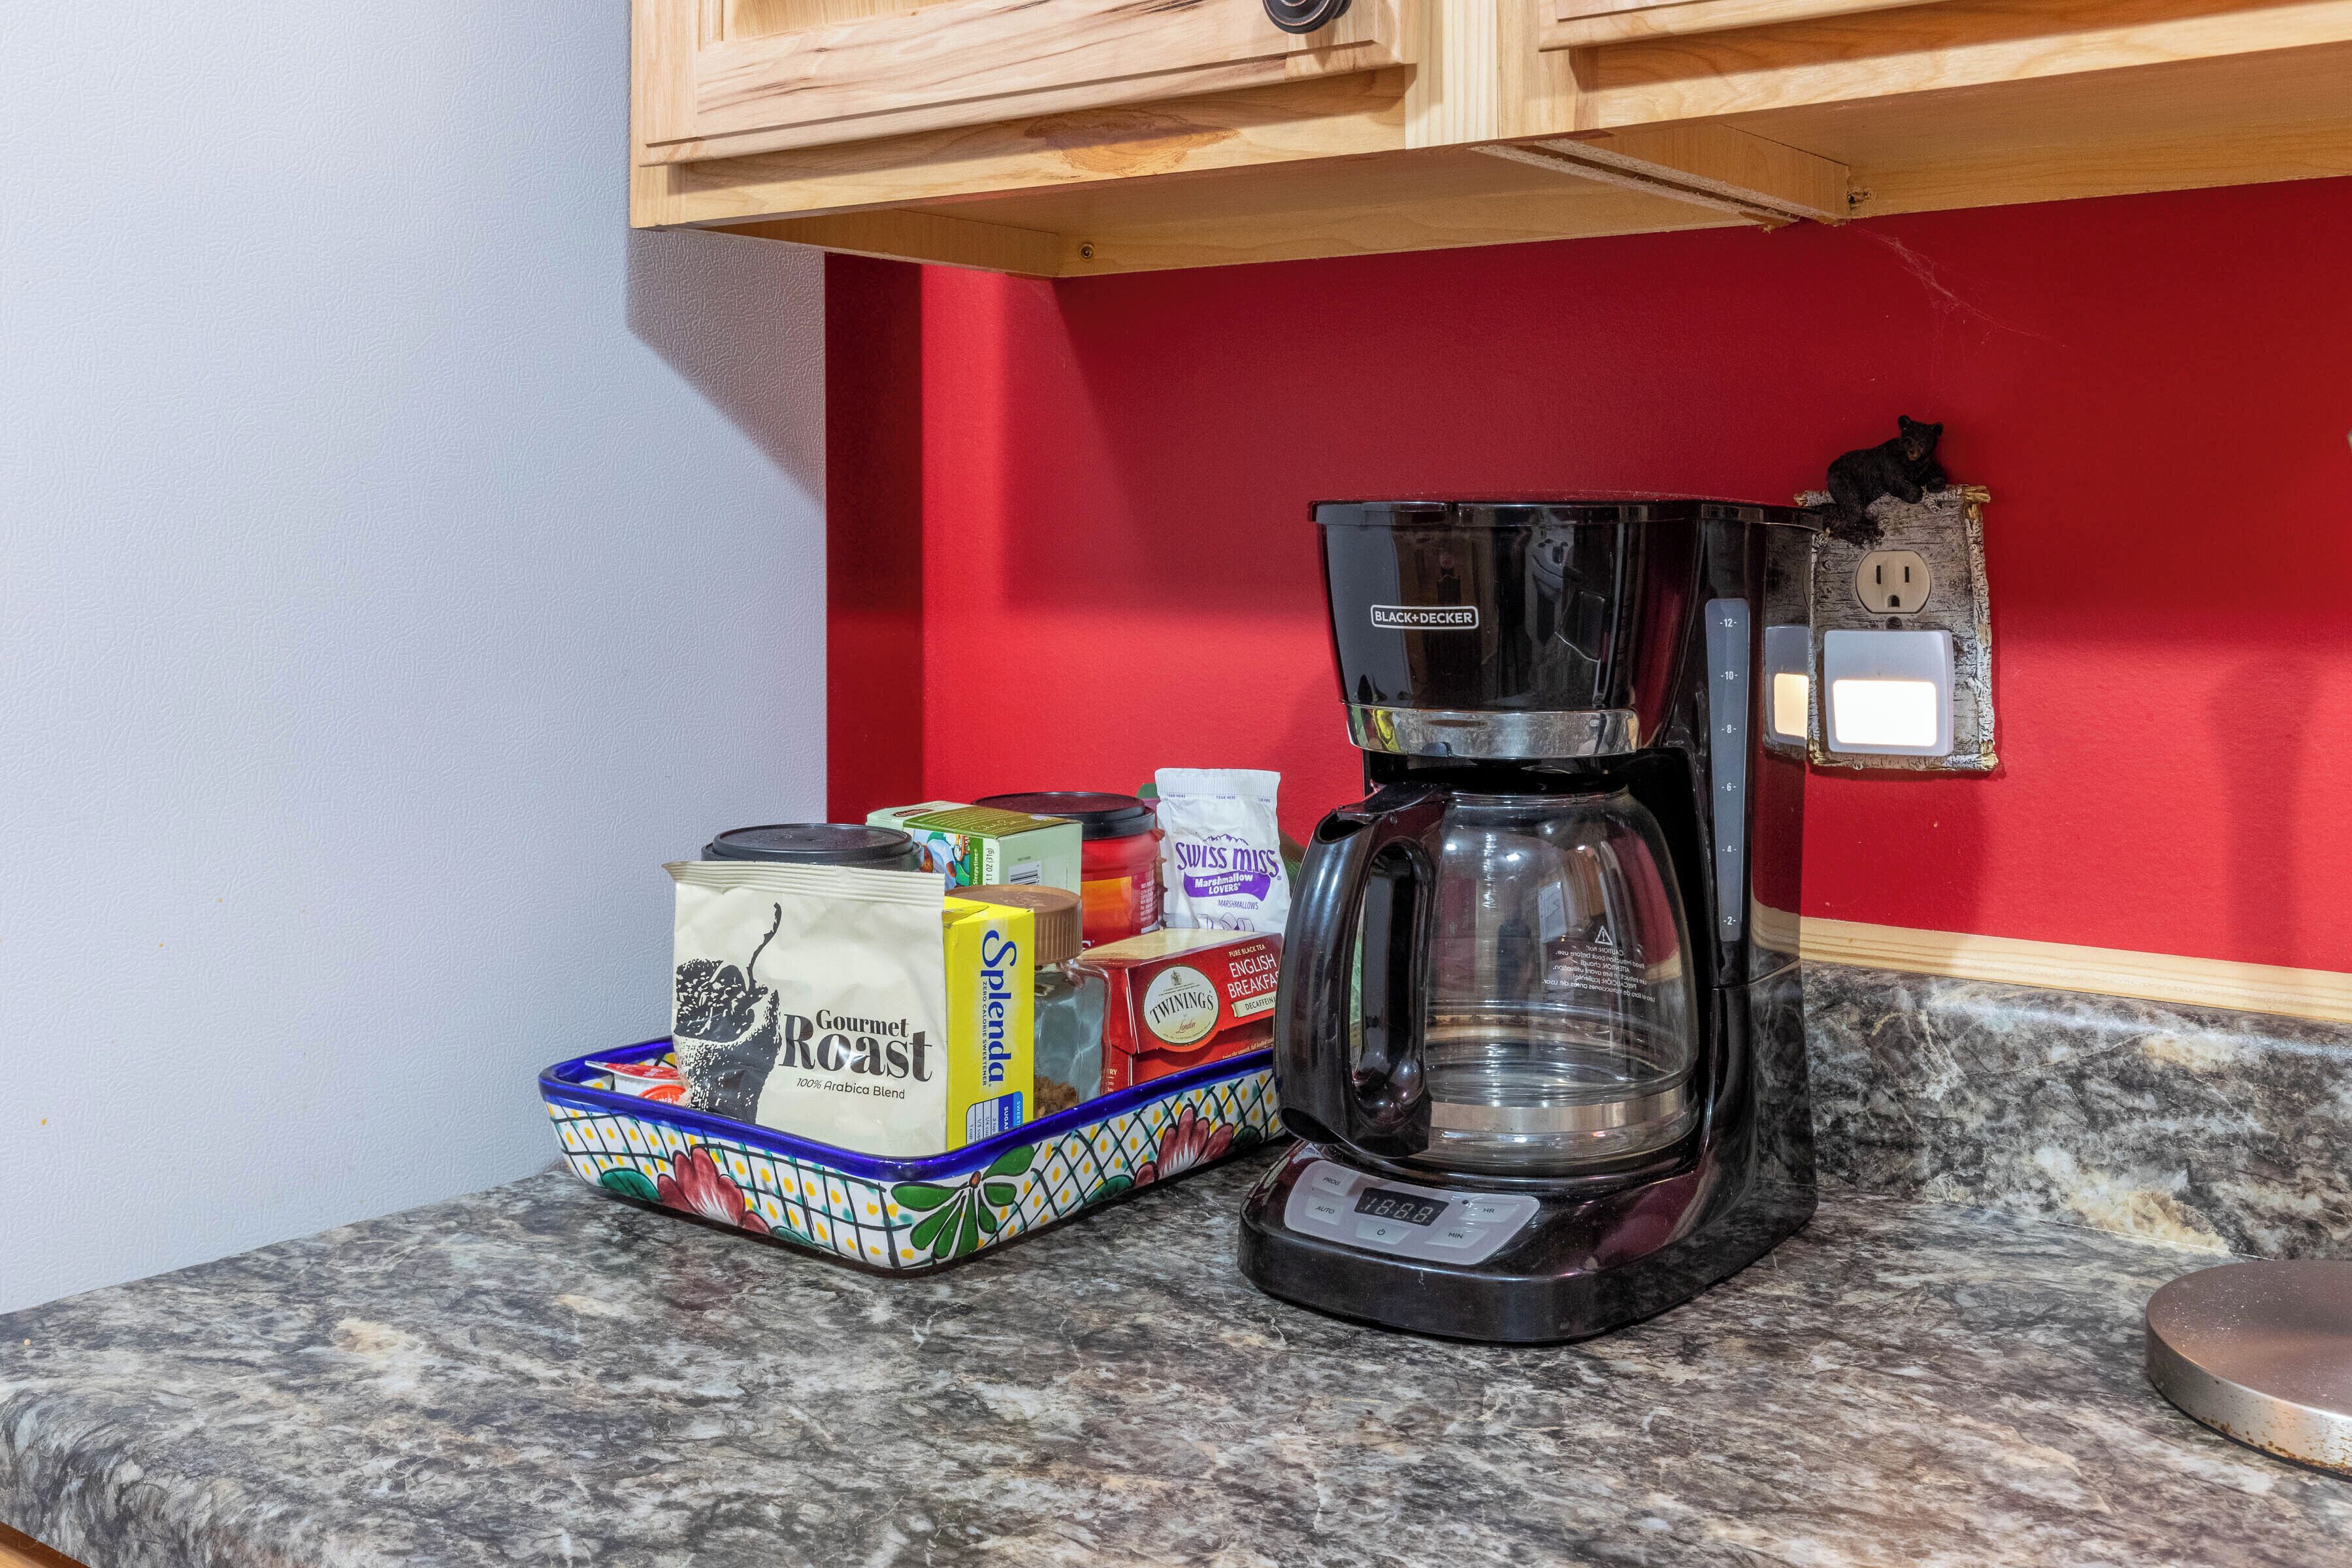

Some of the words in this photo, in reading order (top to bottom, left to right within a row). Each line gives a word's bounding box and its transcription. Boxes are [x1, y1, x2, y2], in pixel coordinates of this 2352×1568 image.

[1375, 610, 1473, 624] BLACK+DECKER
[986, 848, 994, 862] (31g)
[1175, 841, 1228, 871] SWISS
[985, 864, 992, 872] OZ
[1194, 873, 1253, 889] Marshmallow
[1209, 884, 1239, 894] LOVERS
[1217, 900, 1259, 910] MARSHMALLOWS
[1228, 949, 1241, 957] PURE
[1241, 945, 1256, 955] BLACK
[1229, 953, 1277, 978] ENGLISH
[981, 930, 1017, 1083] Splenda
[1150, 992, 1214, 1024] TWININGS
[816, 1009, 909, 1038] Gourmet
[778, 1013, 933, 1082] Roast
[796, 1077, 823, 1089] 100%
[824, 1081, 870, 1095] Arabica
[873, 1086, 905, 1100] Blend
[1323, 1177, 1341, 1186] PROG
[1316, 1205, 1335, 1214] AUTO
